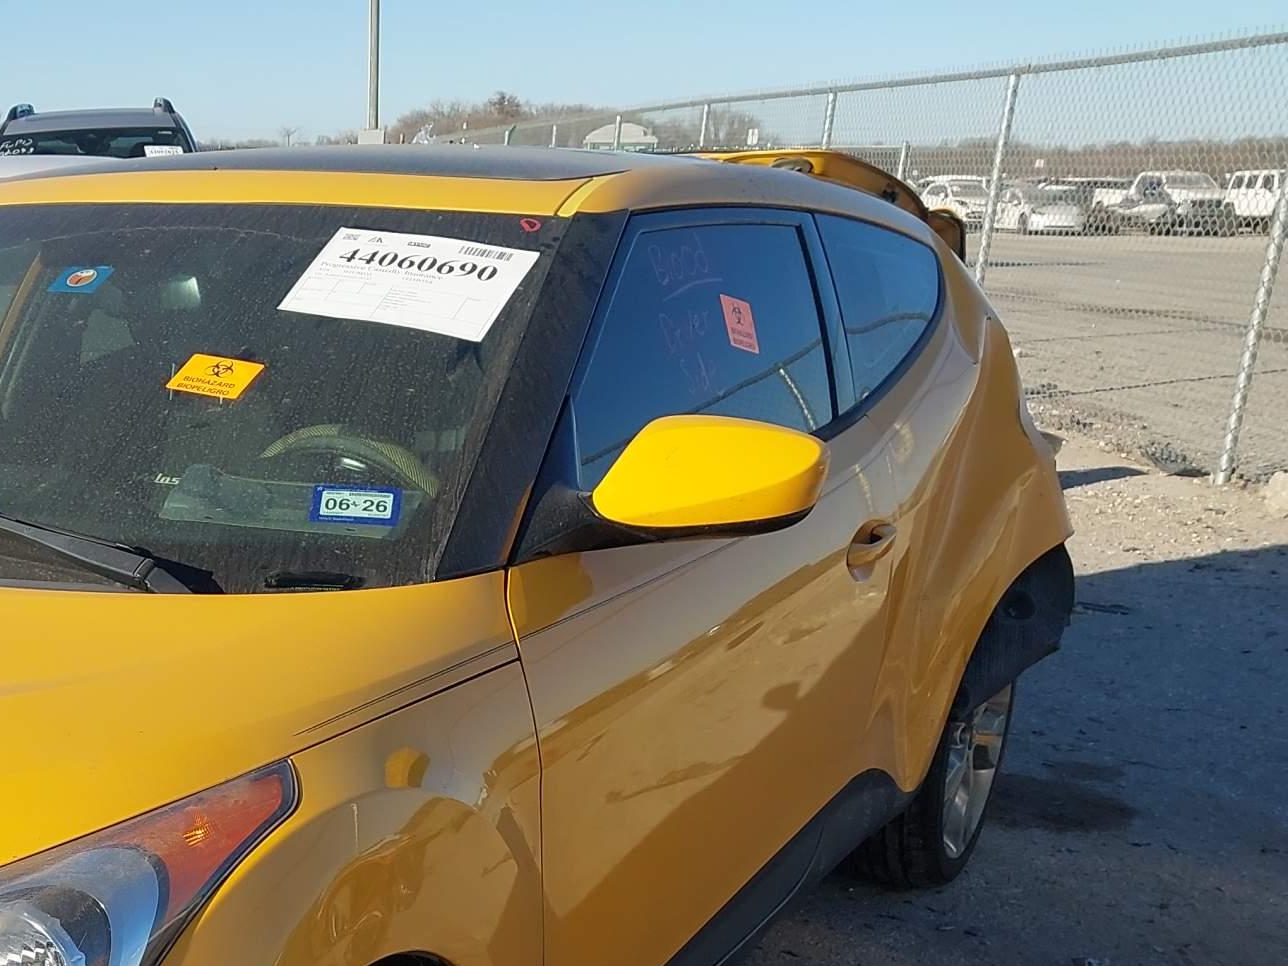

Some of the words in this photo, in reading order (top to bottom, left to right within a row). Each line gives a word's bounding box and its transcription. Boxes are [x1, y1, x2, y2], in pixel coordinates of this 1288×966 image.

[339, 248, 498, 281] 44060690
[177, 383, 230, 396] BIOPELIGRO
[183, 376, 236, 389] BIOHAZARD
[325, 498, 351, 511] 06
[362, 499, 388, 513] 26
